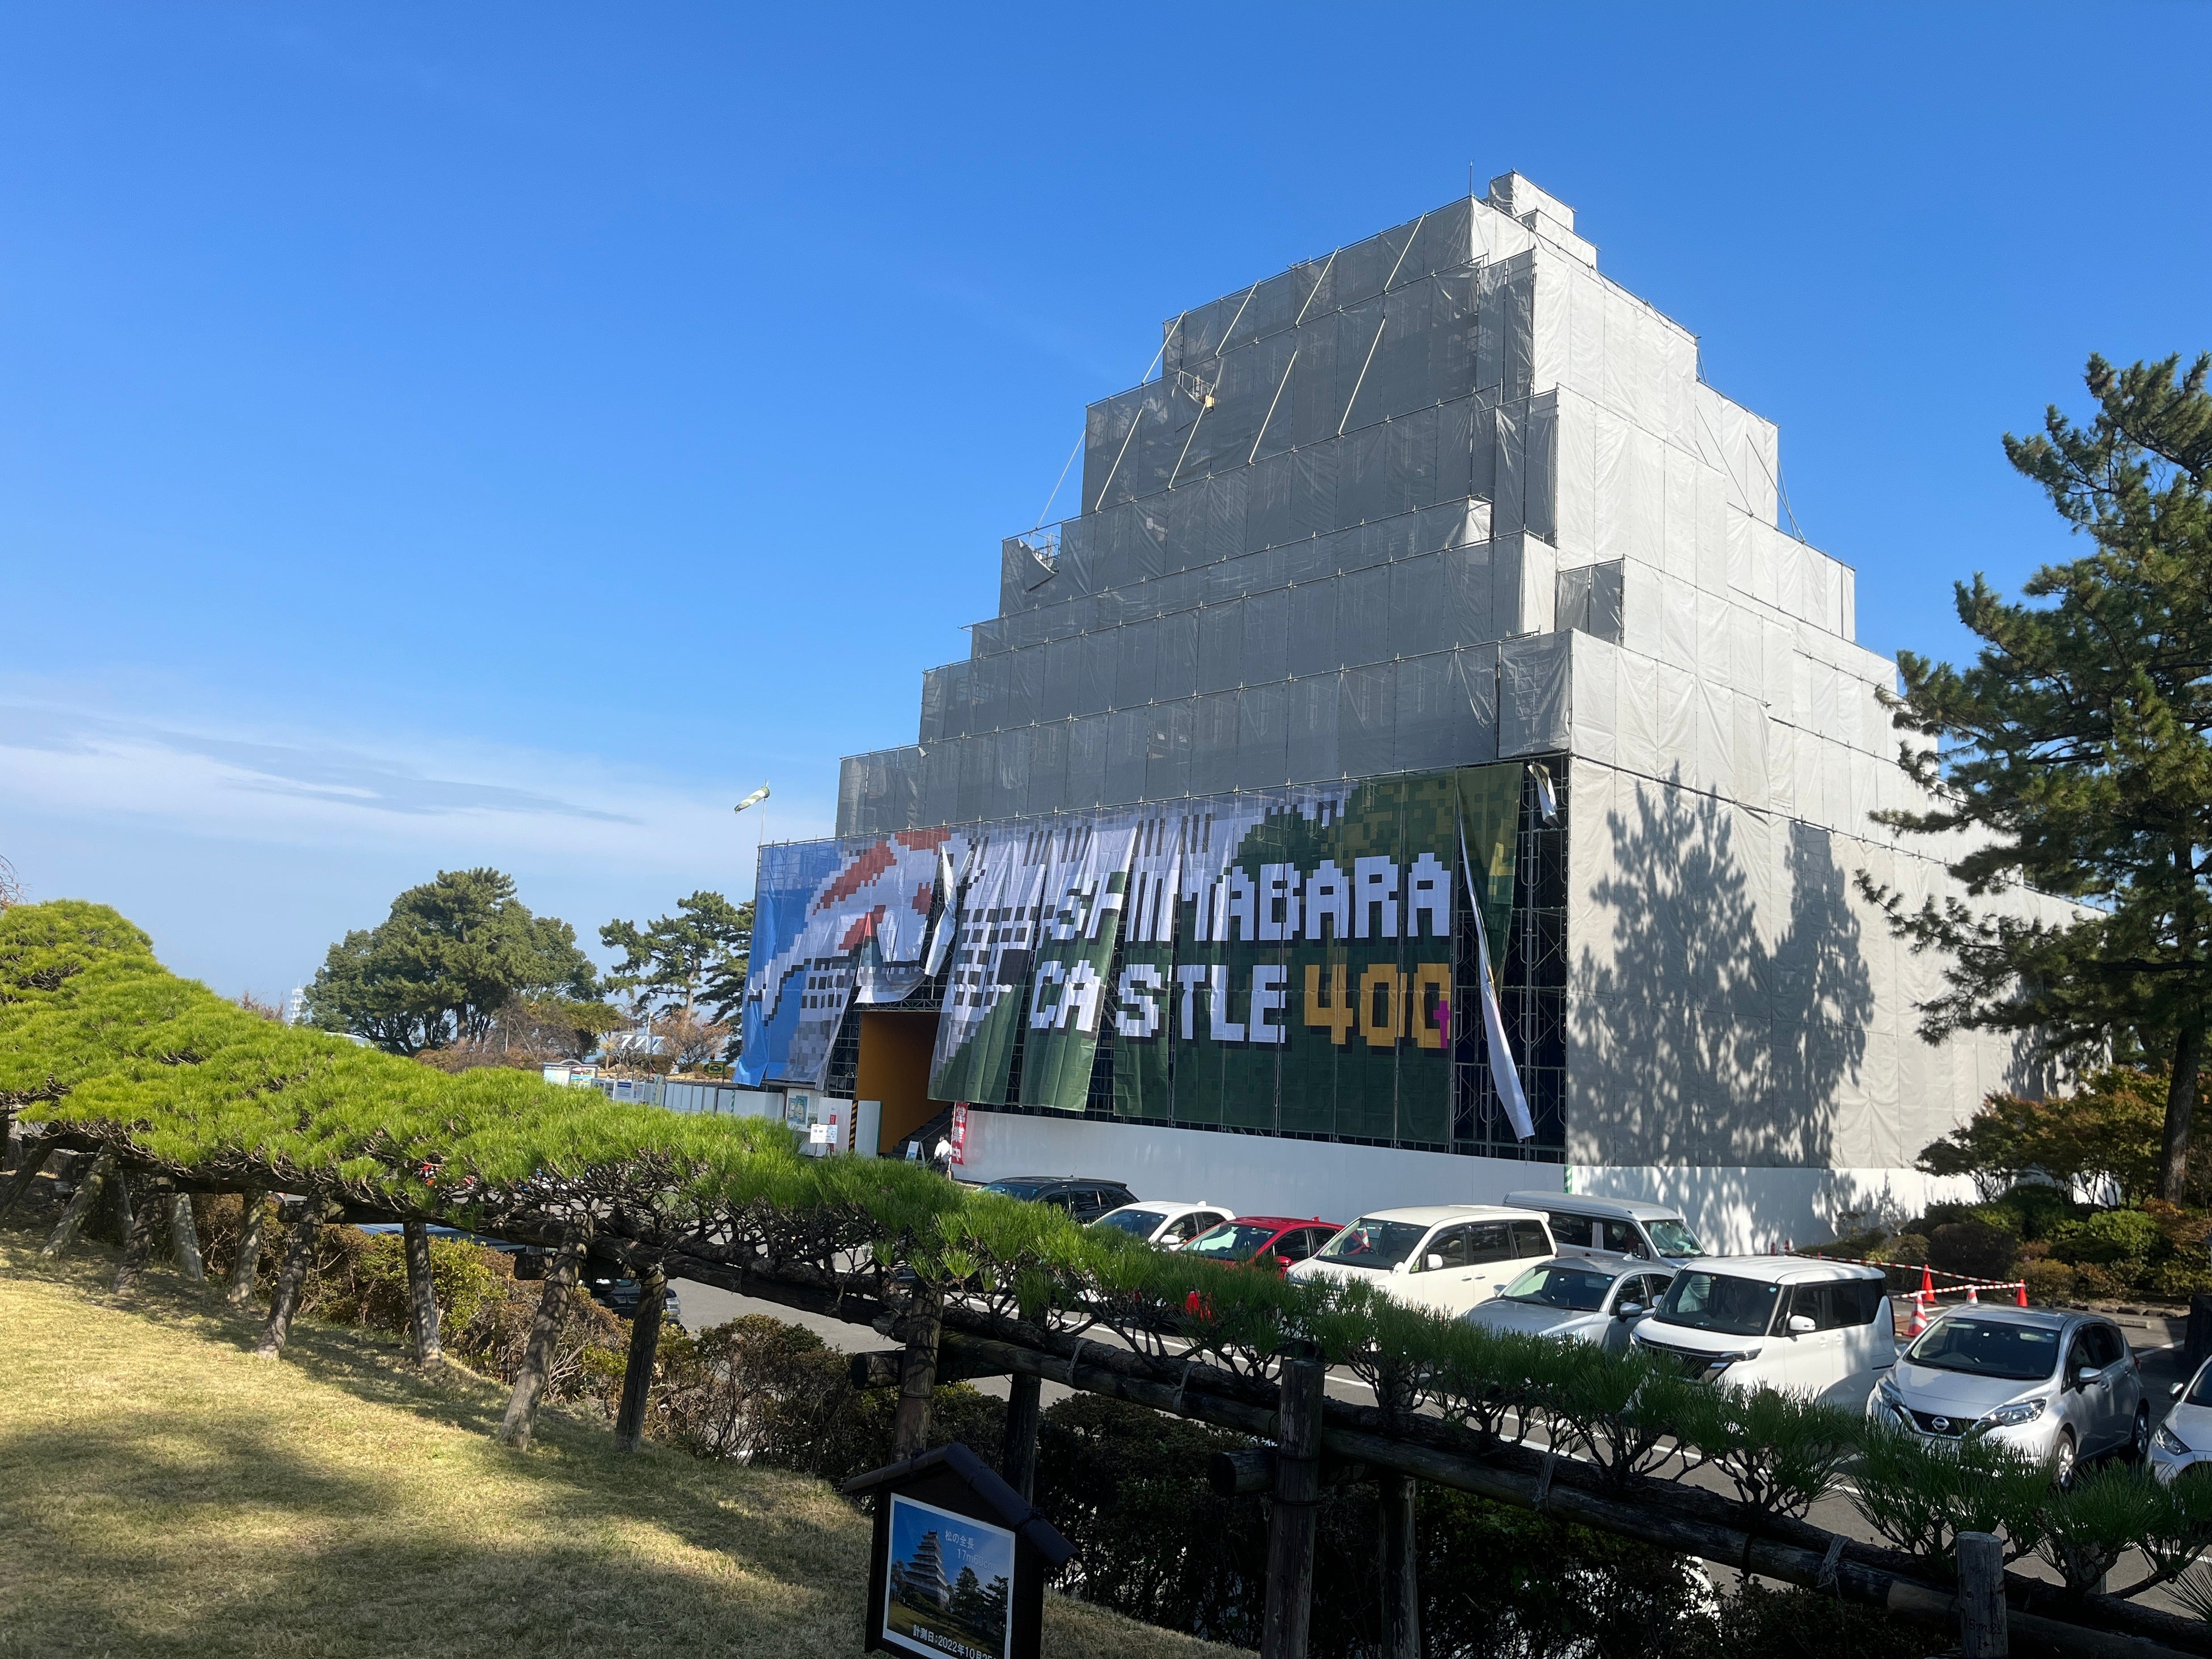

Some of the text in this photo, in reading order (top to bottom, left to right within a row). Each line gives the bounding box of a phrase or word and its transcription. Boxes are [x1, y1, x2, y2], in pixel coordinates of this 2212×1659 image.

[1029, 960, 1451, 1048] CASTLE 400
[945, 1530, 974, 1550] 松の全長
[957, 1548, 995, 1572] 17m60cm
